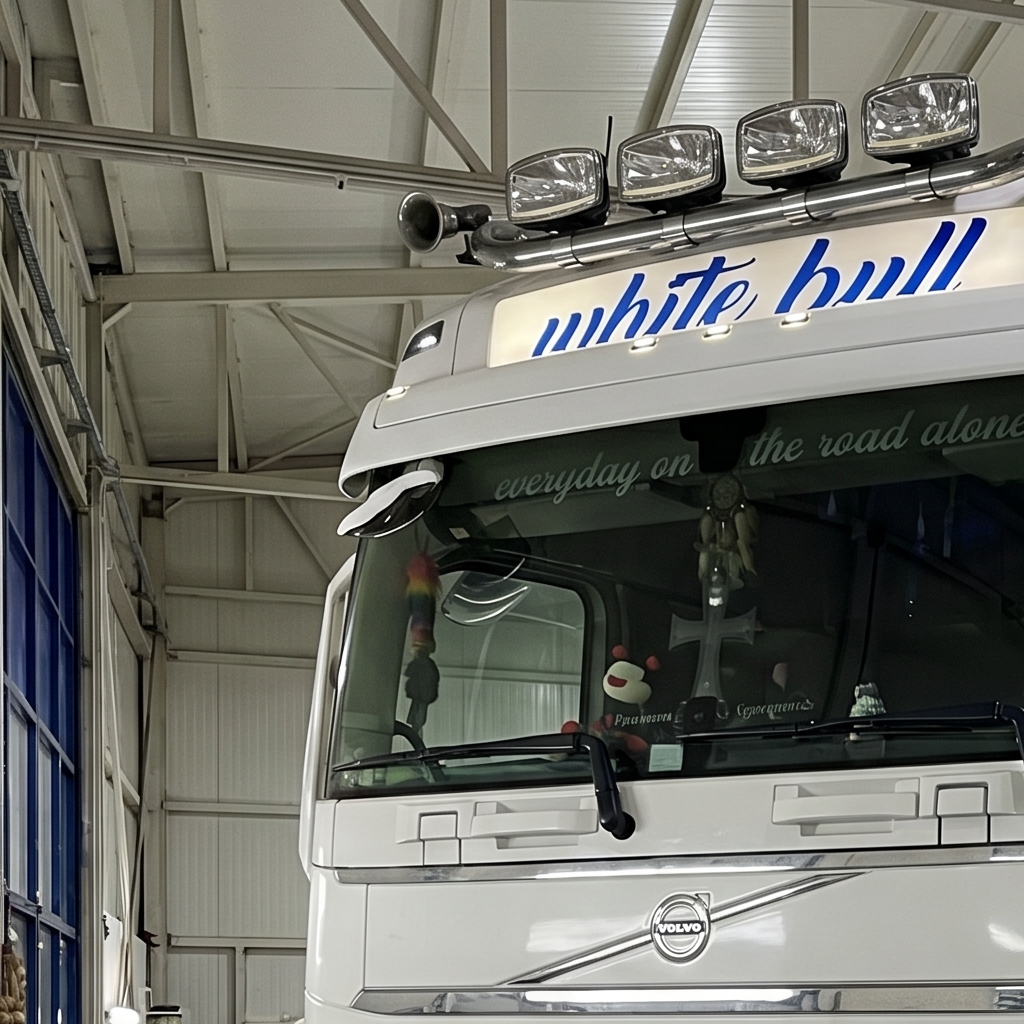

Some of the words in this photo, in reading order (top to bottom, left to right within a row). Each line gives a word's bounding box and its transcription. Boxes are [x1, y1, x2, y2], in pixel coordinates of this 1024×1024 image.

[531, 256, 758, 358] white
[775, 217, 988, 314] bull
[494, 451, 641, 504] everyday
[650, 453, 695, 481] on
[749, 426, 804, 467] the
[818, 409, 915, 458] road
[657, 922, 702, 934] VOLVO
